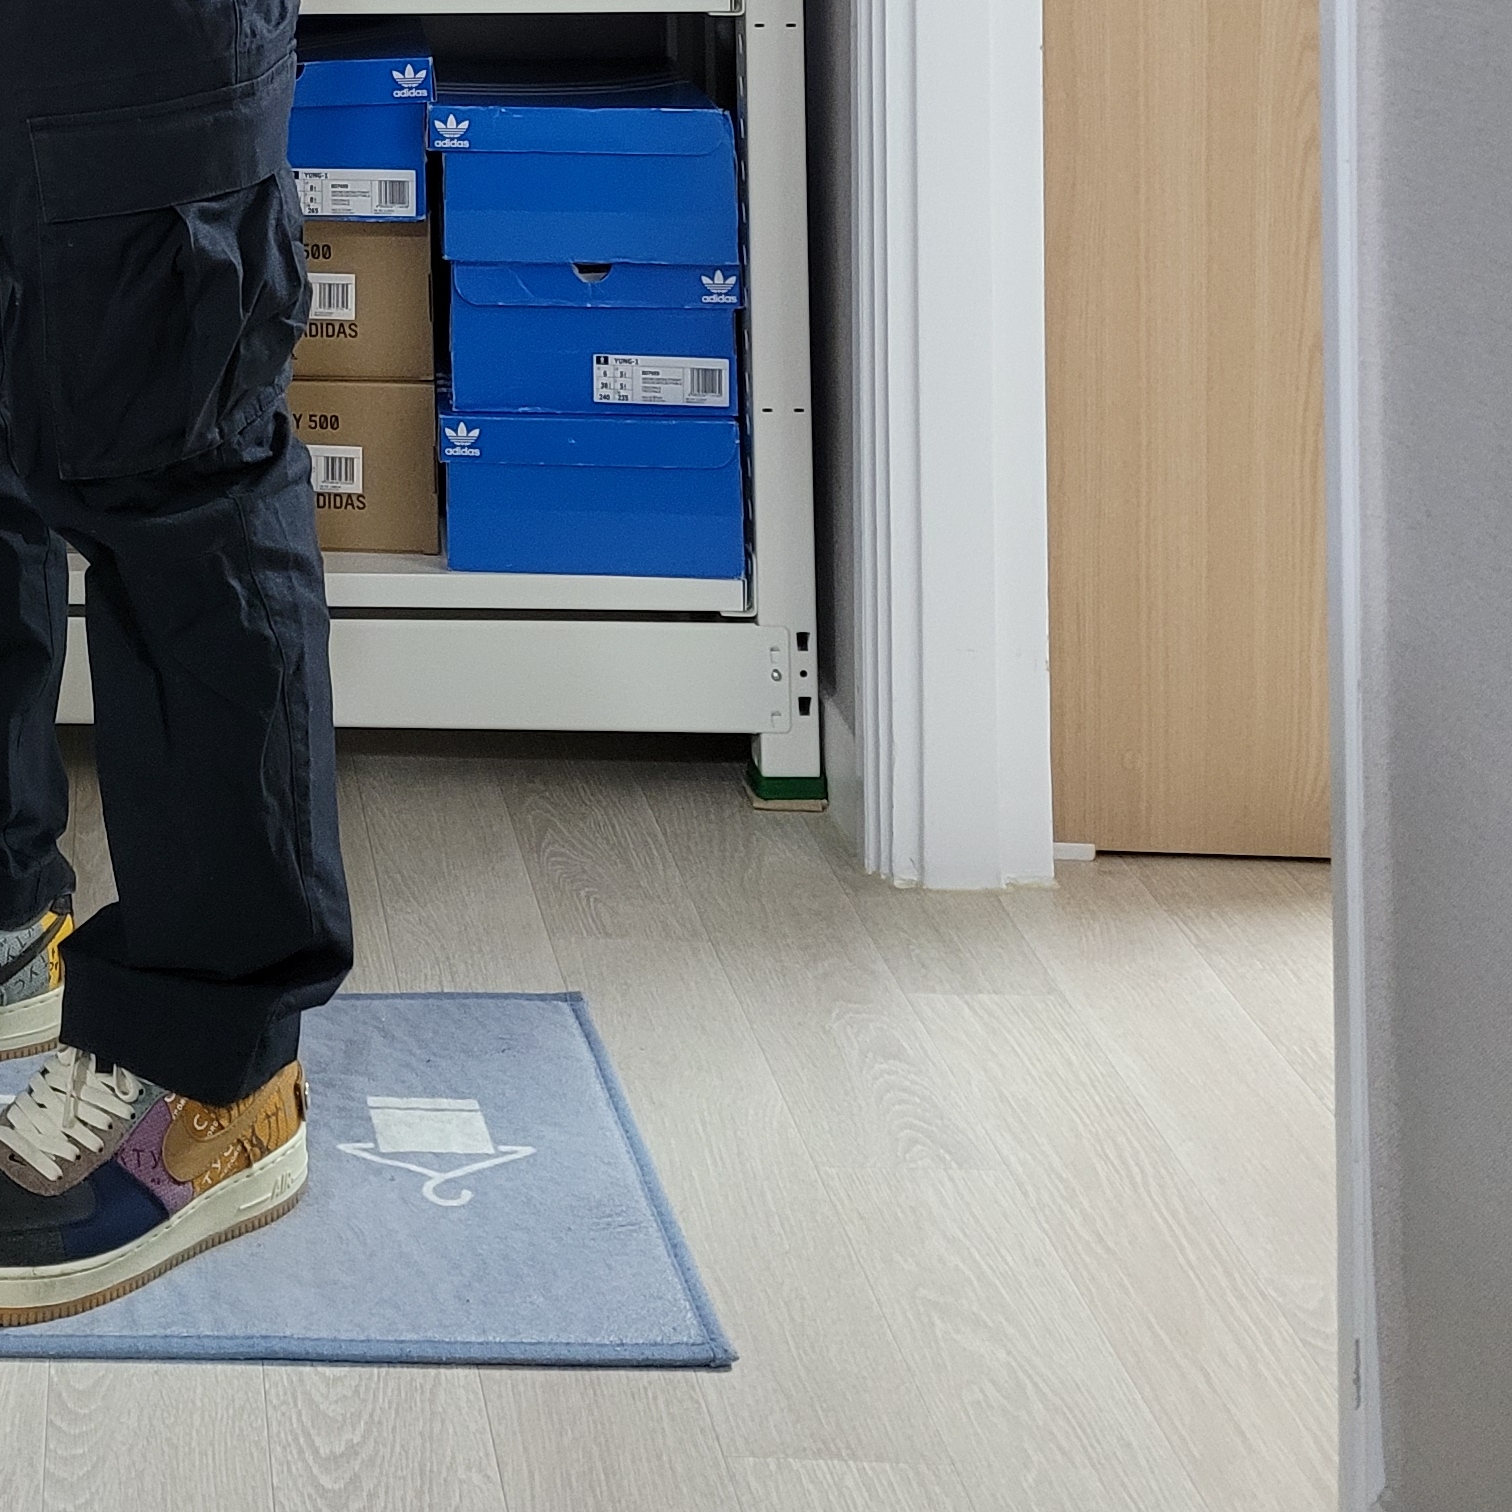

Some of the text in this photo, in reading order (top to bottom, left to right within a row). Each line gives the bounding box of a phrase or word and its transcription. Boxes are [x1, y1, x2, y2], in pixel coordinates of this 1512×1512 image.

[392, 88, 428, 99] adidas
[434, 138, 470, 149] adidas
[701, 294, 738, 304] adidas
[613, 358, 639, 366] YUNG-1
[308, 414, 340, 431] 500
[444, 445, 481, 457] adidas
[316, 493, 367, 511] DIDAS
